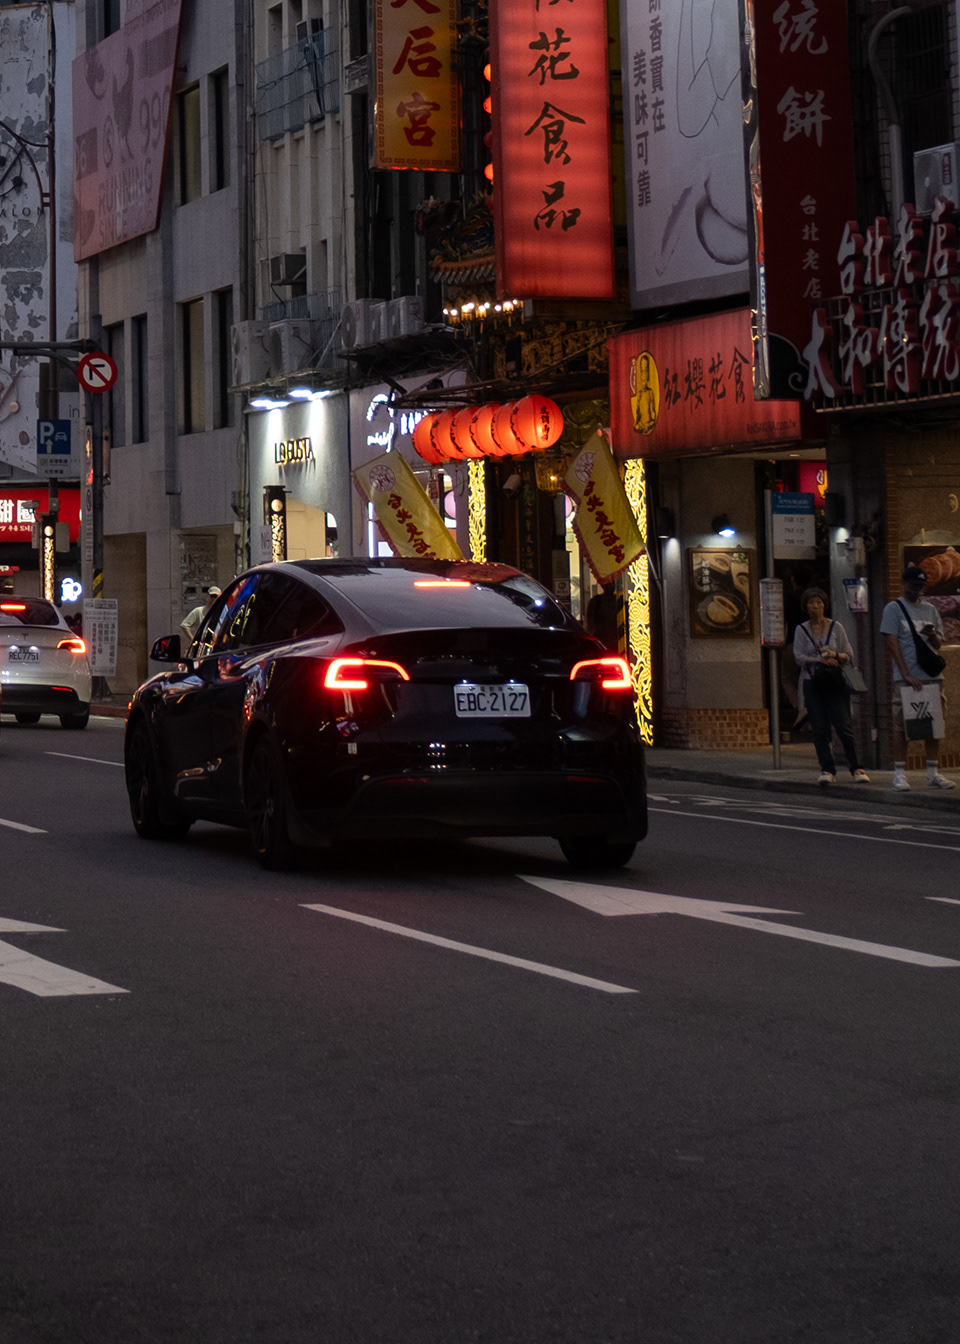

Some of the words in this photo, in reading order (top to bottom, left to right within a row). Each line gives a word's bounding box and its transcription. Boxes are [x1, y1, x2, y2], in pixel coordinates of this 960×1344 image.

[632, 51, 652, 208] 美味可靠
[799, 194, 823, 300] 台北老店
[837, 197, 959, 296] 台北老店
[40, 421, 55, 444] P
